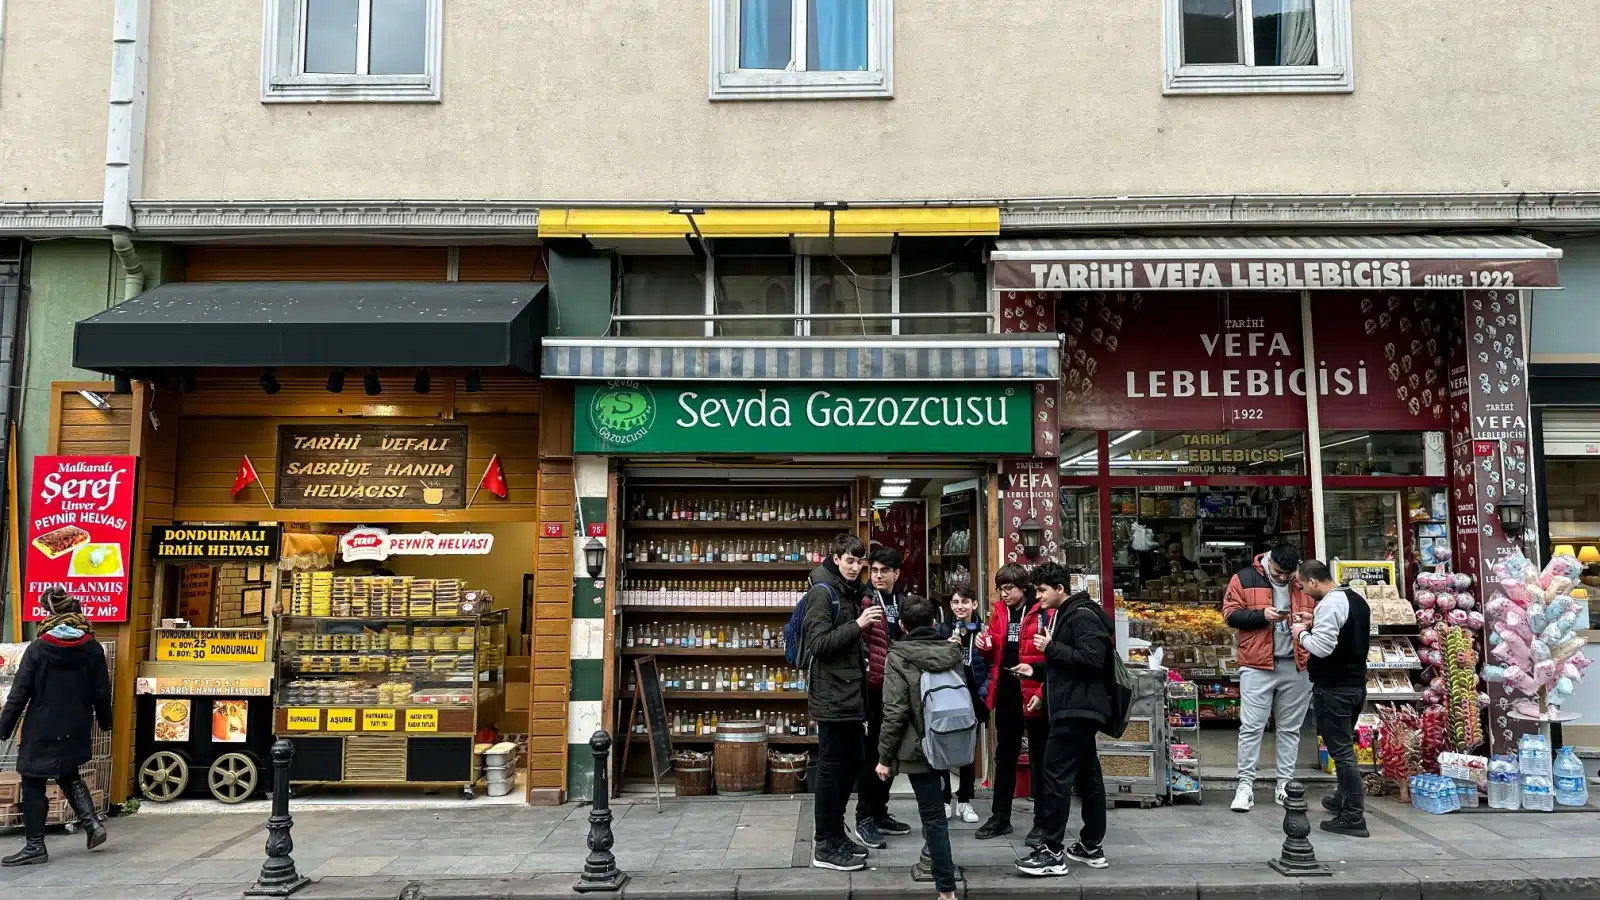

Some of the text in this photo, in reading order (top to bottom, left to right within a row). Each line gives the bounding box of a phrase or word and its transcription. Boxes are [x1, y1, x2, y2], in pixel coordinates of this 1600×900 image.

[1143, 262, 1222, 288] VEFA
[1424, 274, 1464, 288] SINCE
[1470, 271, 1515, 288] 1922
[1200, 333, 1292, 357] VEFA
[1450, 376, 1468, 390] VEFA
[676, 388, 1008, 428] Sevda Gazozcusu
[1234, 409, 1264, 420] 1922
[1476, 416, 1526, 428] VEFA
[598, 426, 648, 444] Gazozcusu
[294, 434, 450, 451] TARİHİ VEFALI
[1128, 449, 1174, 461] VEFA
[58, 462, 114, 472] Malkaralı
[286, 458, 454, 477] SABRİYE HANIM
[1008, 473, 1052, 488] VEFA
[40, 468, 126, 510] Şeref
[303, 484, 409, 498] HELVACISI
[34, 510, 128, 531] PEYNİR HELVASI
[1457, 515, 1478, 526] VEFA
[164, 530, 266, 542] DONDURMALI
[158, 542, 270, 556] İRMİK HELVASI
[390, 536, 434, 550] PEYNİR
[438, 538, 488, 550] HELVASI
[98, 604, 118, 616] Mİ?
[162, 630, 200, 640] DONDURMALI
[200, 630, 218, 640] SICAK
[238, 630, 262, 640] HELVASI
[194, 640, 206, 648] 25
[210, 646, 258, 654] DONDURMALI
[193, 650, 206, 658] 30
[196, 686, 222, 694] HANIM
[224, 687, 264, 695] HELVACISI
[330, 716, 352, 725] AŞURE
